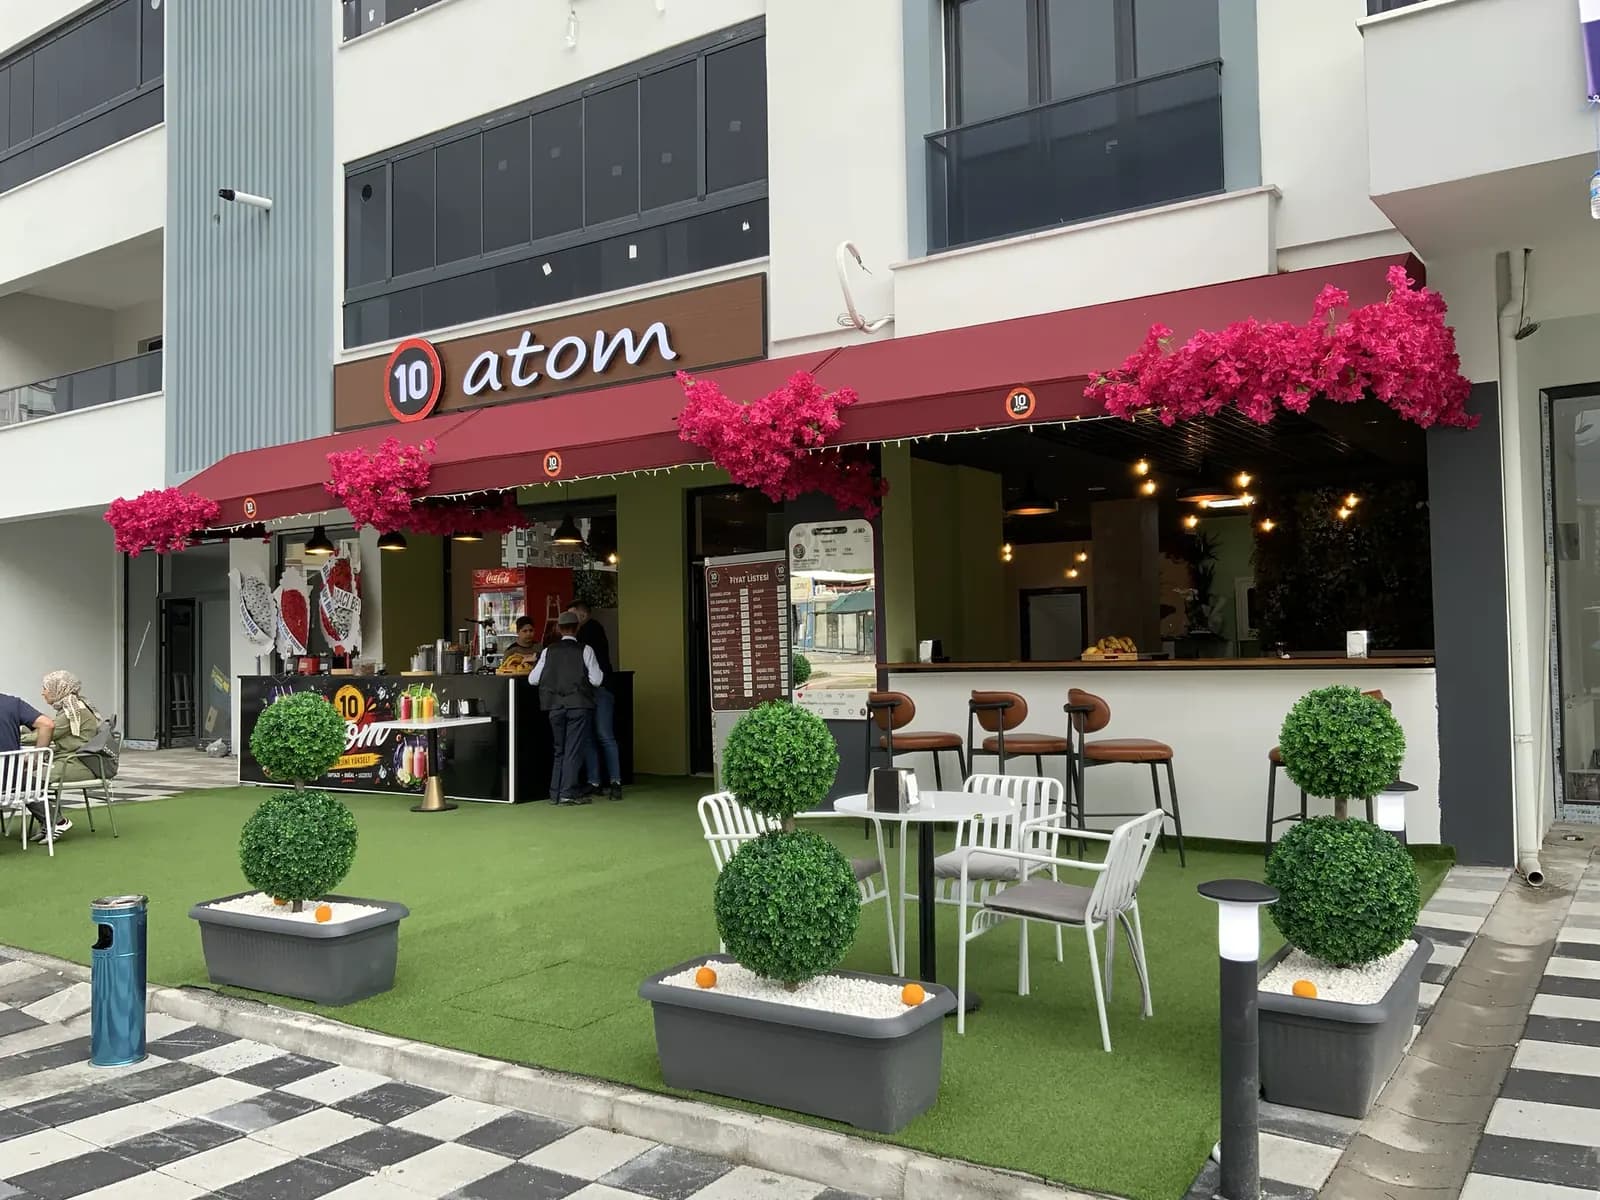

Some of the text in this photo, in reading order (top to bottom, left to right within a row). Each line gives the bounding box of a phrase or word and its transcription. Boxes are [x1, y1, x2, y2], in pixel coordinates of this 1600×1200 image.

[394, 321, 678, 403] 10 atom
[1014, 394, 1026, 406] 10
[548, 457, 557, 466] 10
[340, 695, 359, 718] 10
